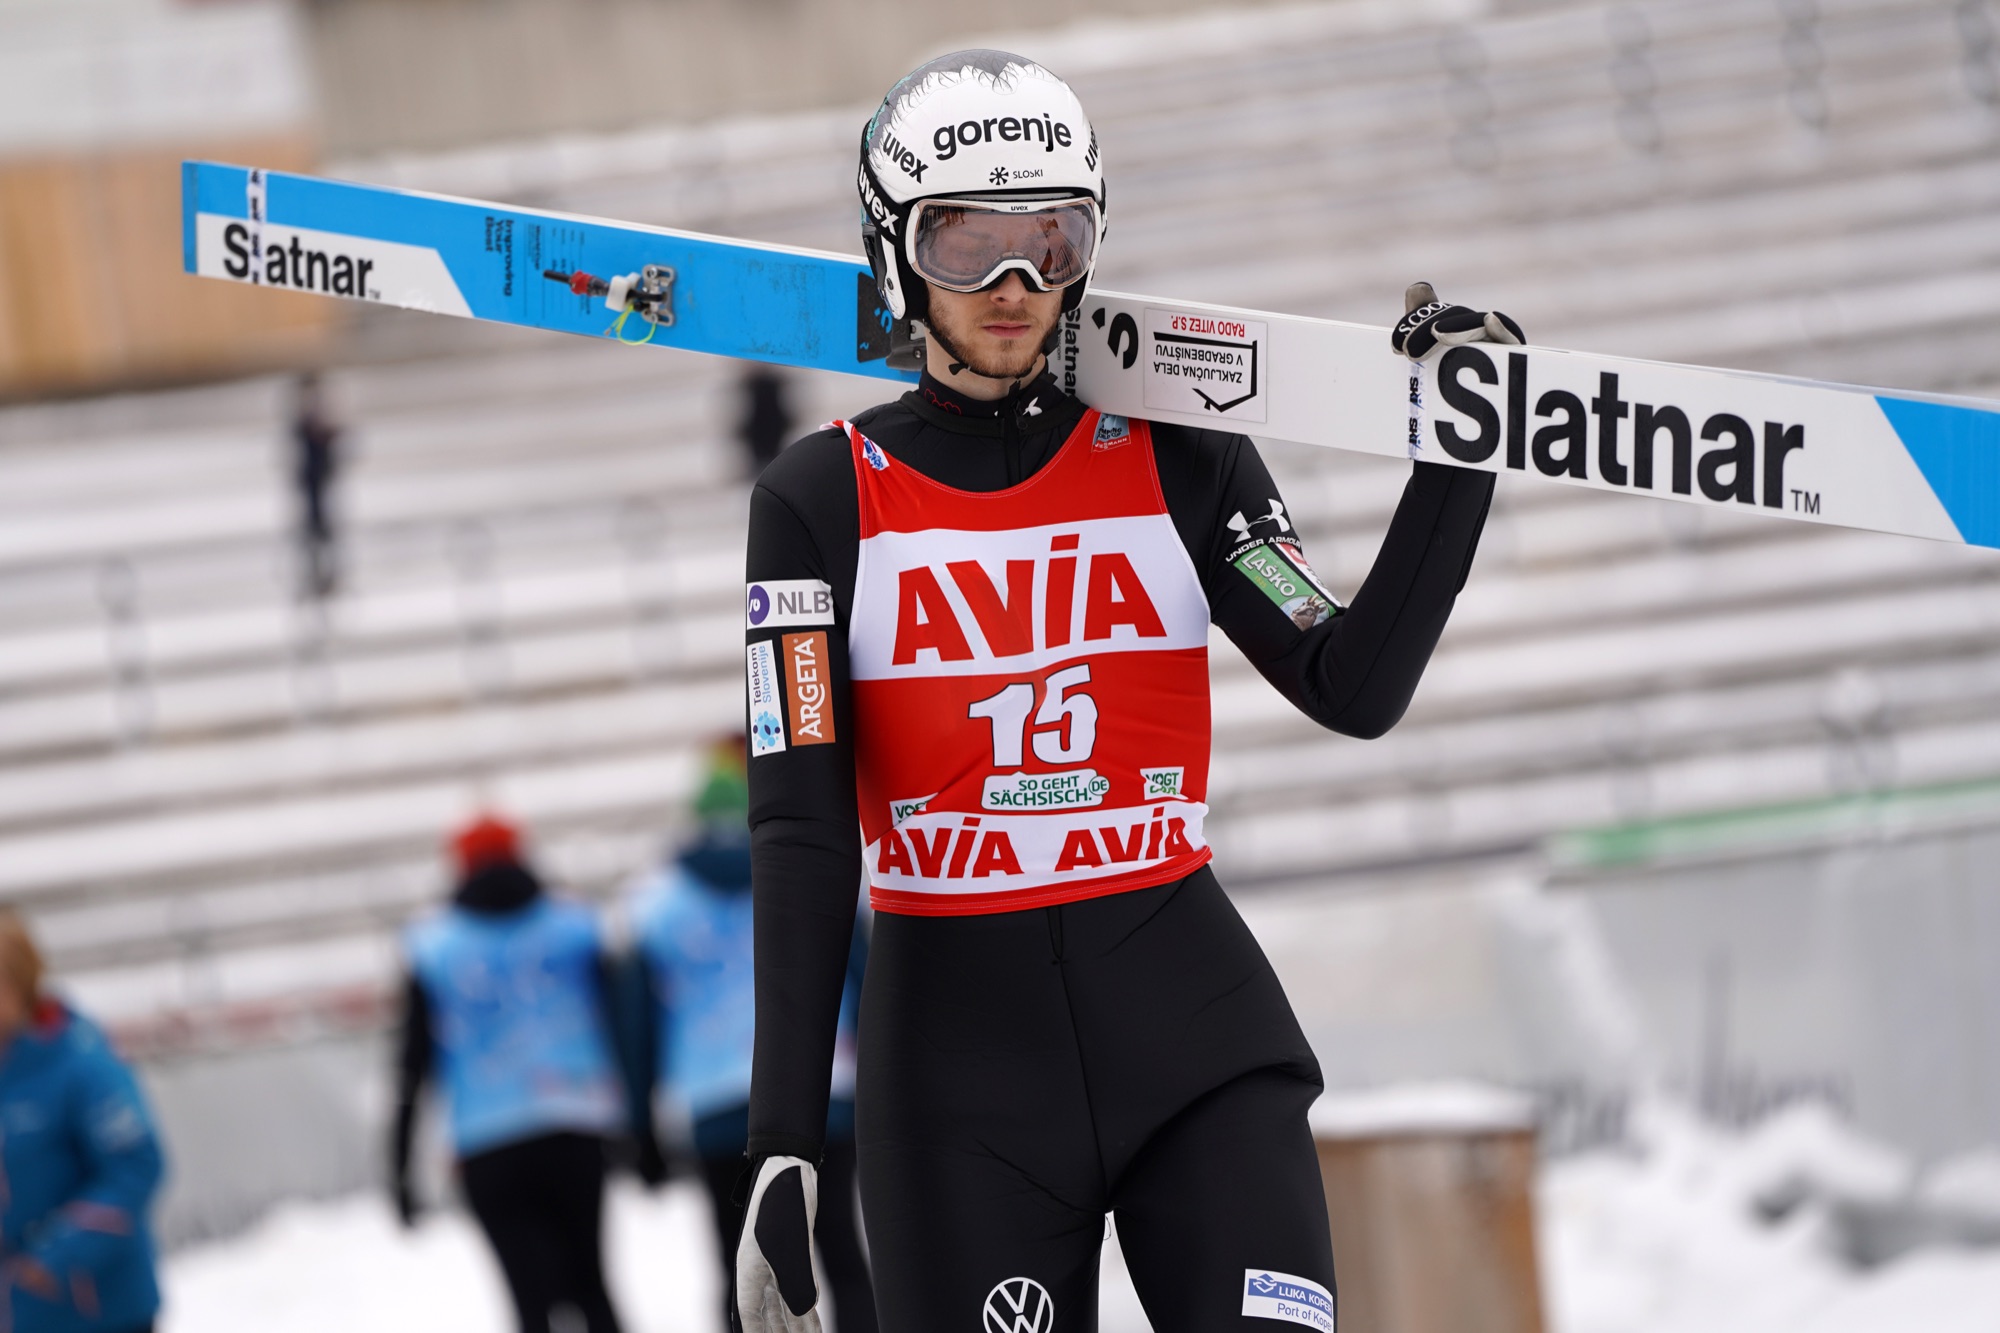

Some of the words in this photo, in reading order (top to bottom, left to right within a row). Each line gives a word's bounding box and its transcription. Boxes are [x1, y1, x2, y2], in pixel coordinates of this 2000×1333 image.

[933, 113, 1072, 161] gorenje
[882, 132, 929, 184] uvex
[858, 164, 900, 236] uvex
[223, 222, 373, 298] Satnar
[504, 219, 514, 296] Improving
[1170, 315, 1187, 331] S.P.
[1189, 317, 1216, 333] VITEZ
[1217, 321, 1245, 338] RADO
[1155, 344, 1234, 365] GRADBENIŠTVU
[1236, 354, 1243, 366] V
[1153, 361, 1180, 376] DELA
[1182, 365, 1243, 384] ZAKLJUČNA
[1434, 346, 1805, 510] Slatnar
[1790, 490, 1821, 515] TM
[1225, 538, 1265, 563] UNDER
[1268, 536, 1301, 549] ARMOUR
[1241, 549, 1296, 597] LAŠKO
[777, 591, 830, 615] NLB
[752, 647, 762, 706] Telekom
[759, 645, 772, 703] Slovenije
[794, 637, 826, 739] ARGETA
[967, 663, 1099, 767] 15
[1018, 779, 1038, 791] SO
[1041, 775, 1080, 790] GEHT
[1091, 779, 1108, 792] DE
[989, 788, 1092, 806] SÄCHSISCH.
[1278, 1285, 1307, 1302] LUKA
[1277, 1302, 1300, 1318] Port
[1301, 1309, 1312, 1321] of
